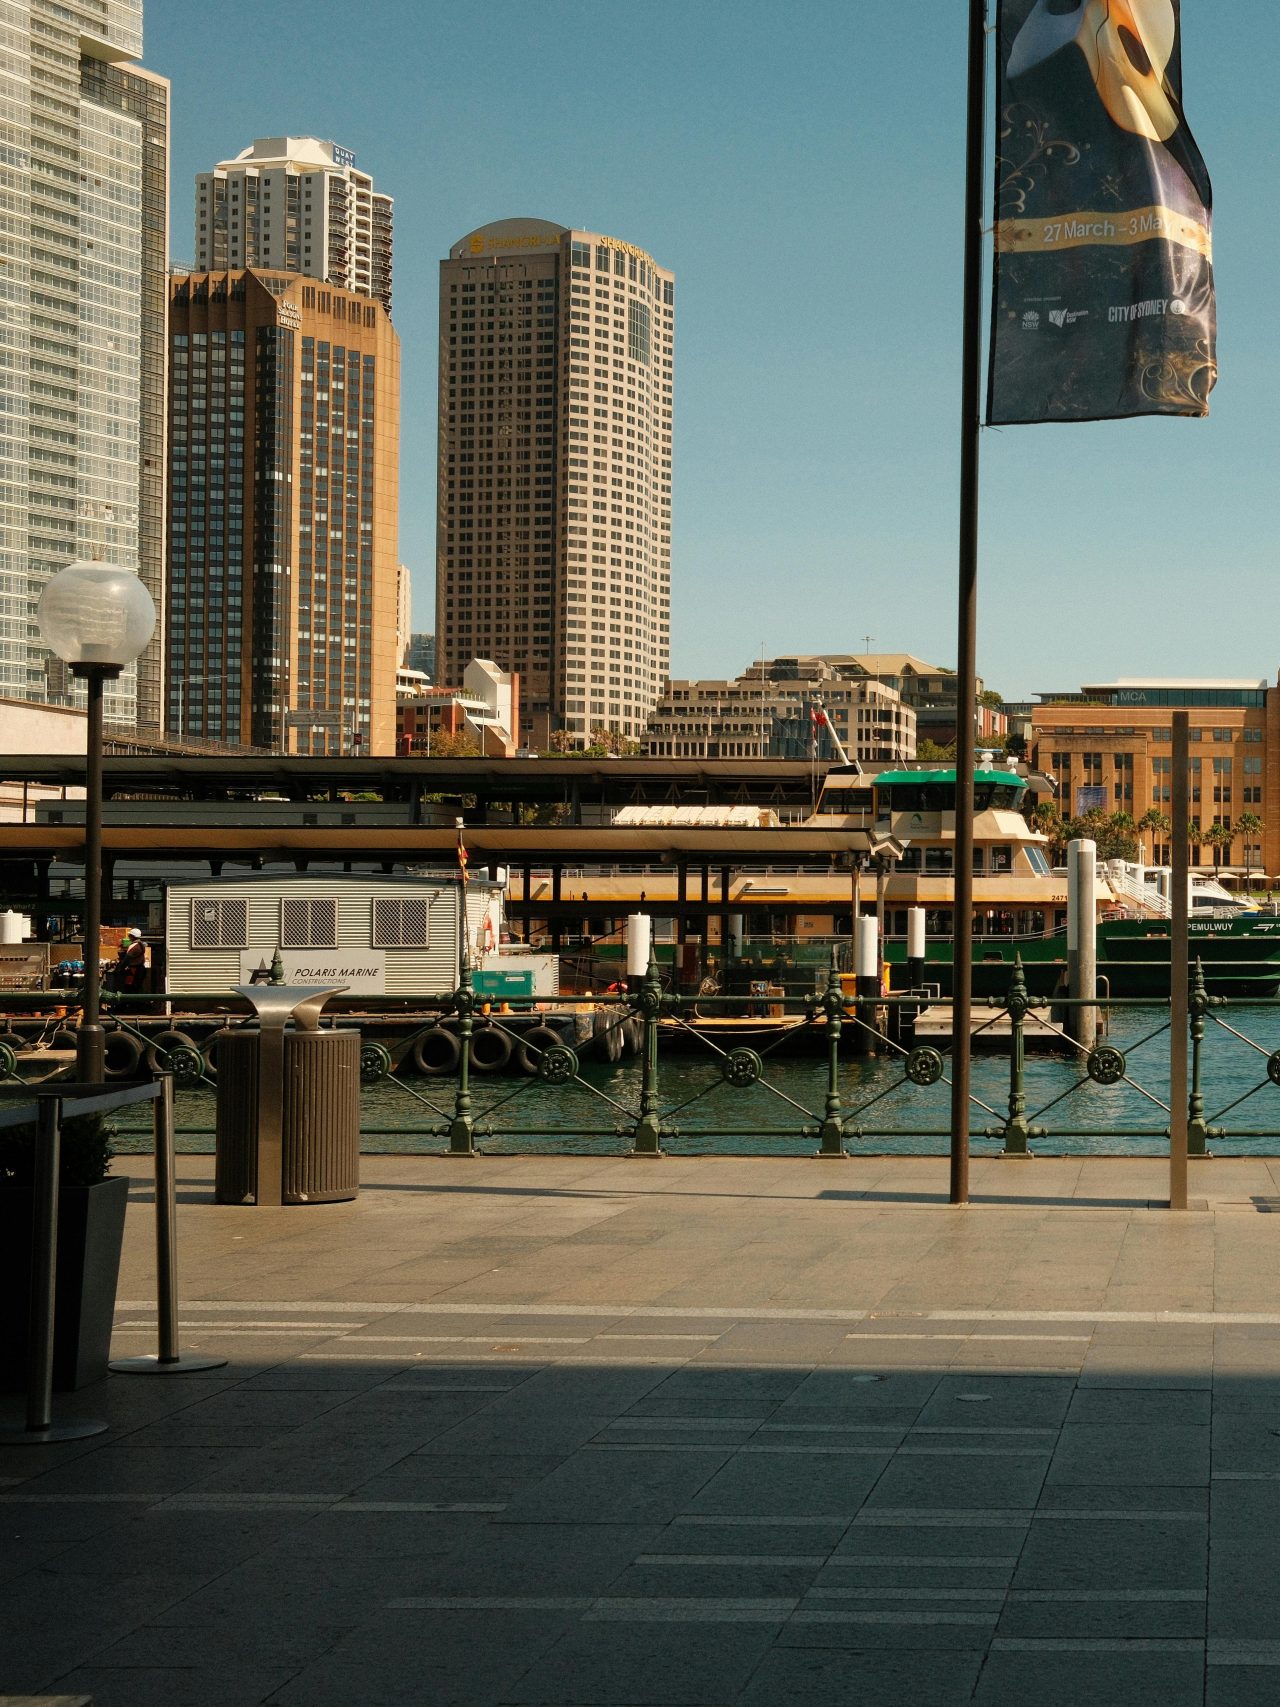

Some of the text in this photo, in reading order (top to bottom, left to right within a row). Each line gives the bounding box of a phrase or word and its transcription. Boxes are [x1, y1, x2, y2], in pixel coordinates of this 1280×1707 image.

[335, 147, 354, 161] QUAY
[1043, 223, 1061, 242] 27
[1064, 220, 1115, 239] March
[1129, 217, 1138, 235] 3
[1108, 299, 1169, 322] CITY OF SYDNEY
[1120, 691, 1147, 701] MCA
[1187, 923, 1234, 931] PEMULWUY
[294, 968, 379, 977] POLARIS MARINE
